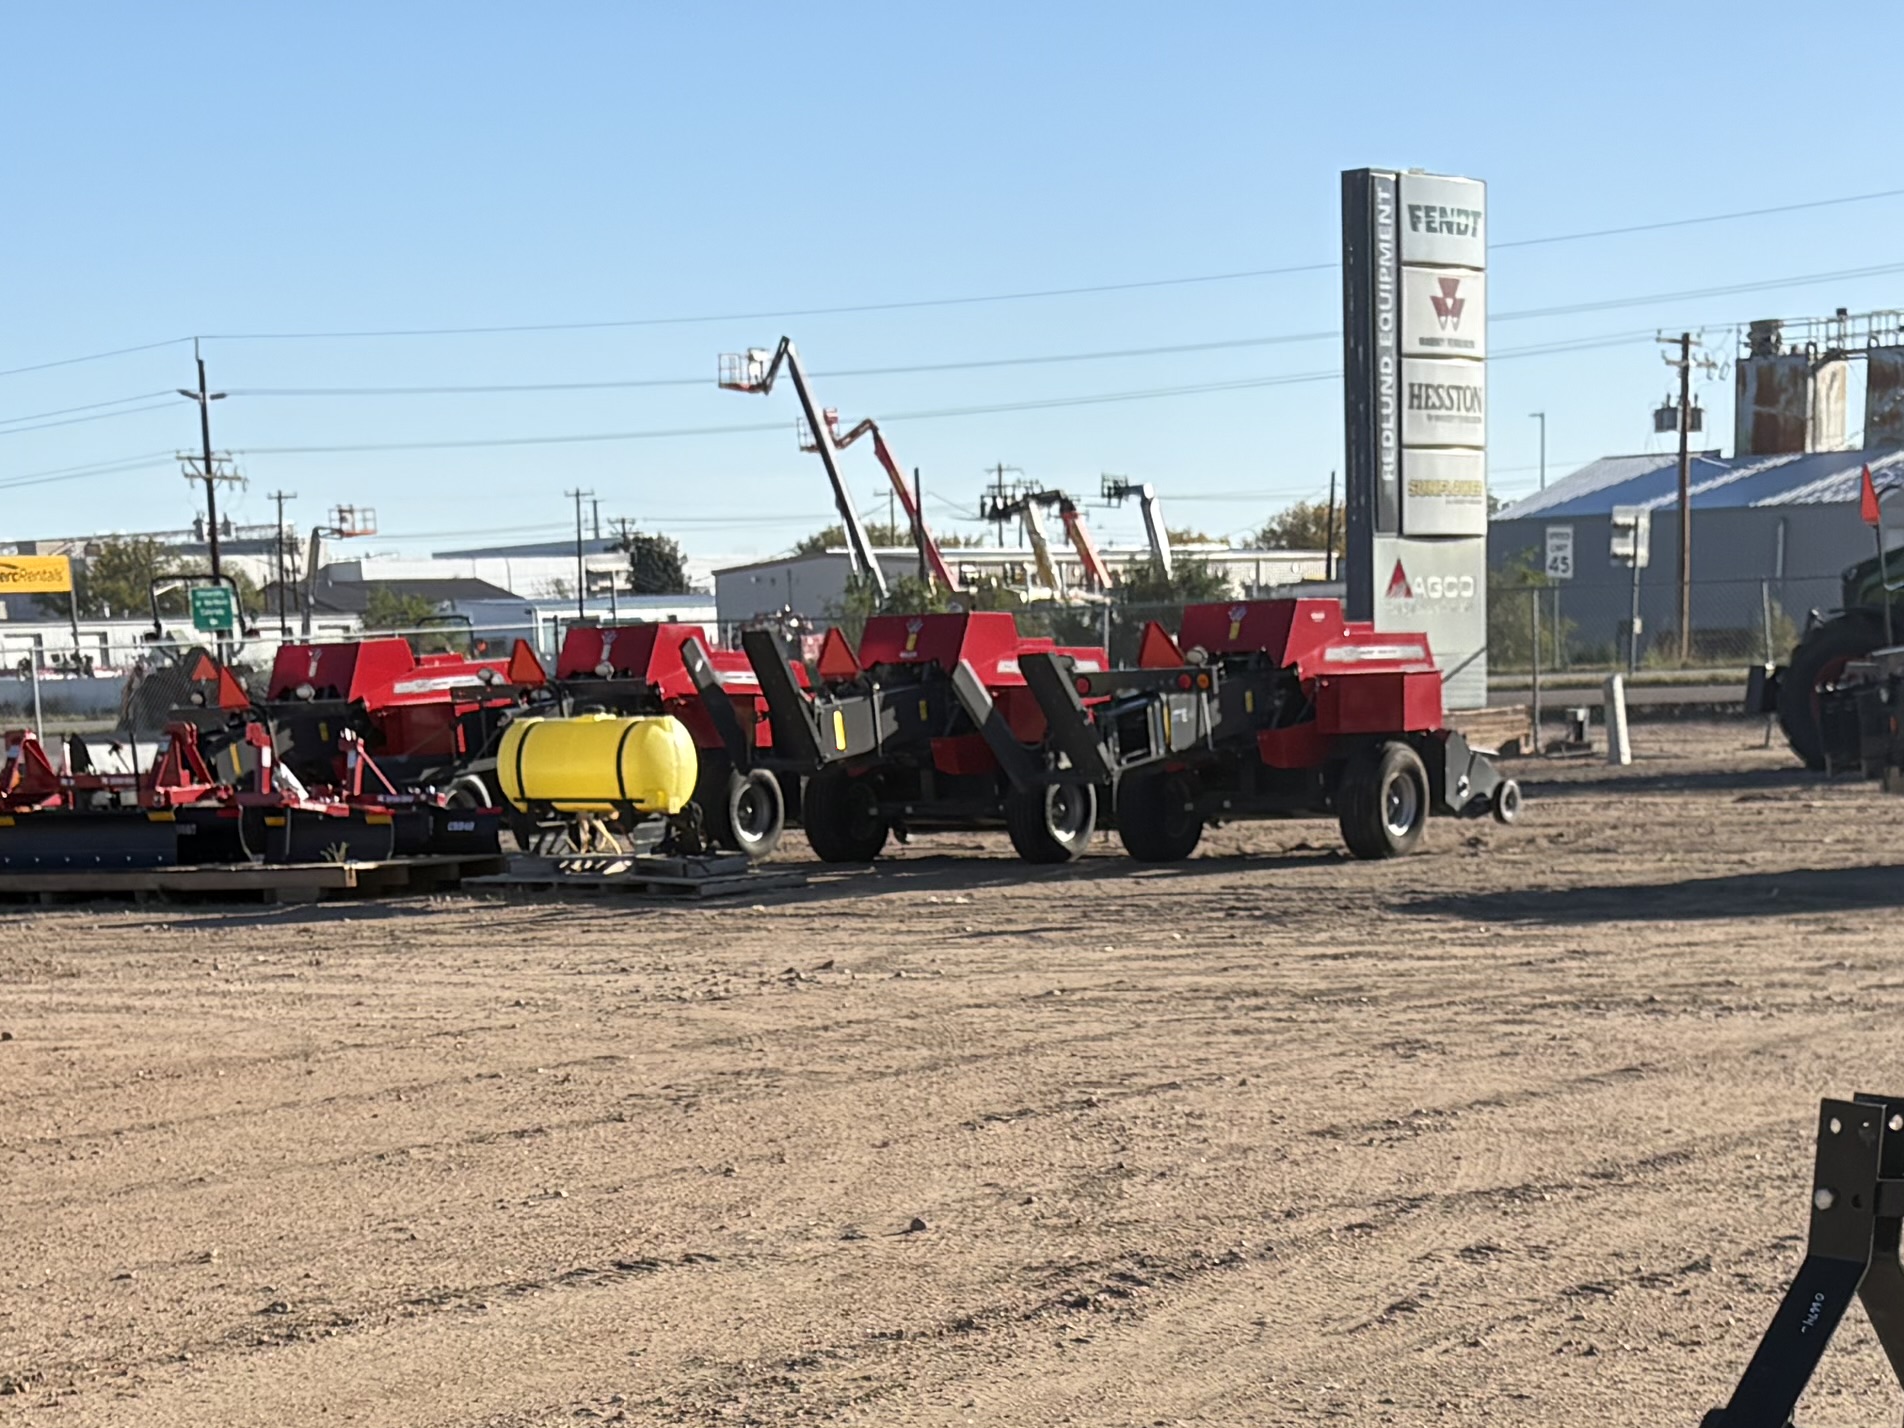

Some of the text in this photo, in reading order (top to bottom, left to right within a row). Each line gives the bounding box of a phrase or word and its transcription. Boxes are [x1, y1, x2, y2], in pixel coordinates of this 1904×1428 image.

[1407, 204, 1482, 238] FENDT
[1377, 187, 1395, 481] REDLUND EQUIPMENT
[1408, 382, 1482, 414] HESSTON
[1548, 556, 1570, 574] 45
[1414, 575, 1475, 600] AGCO
